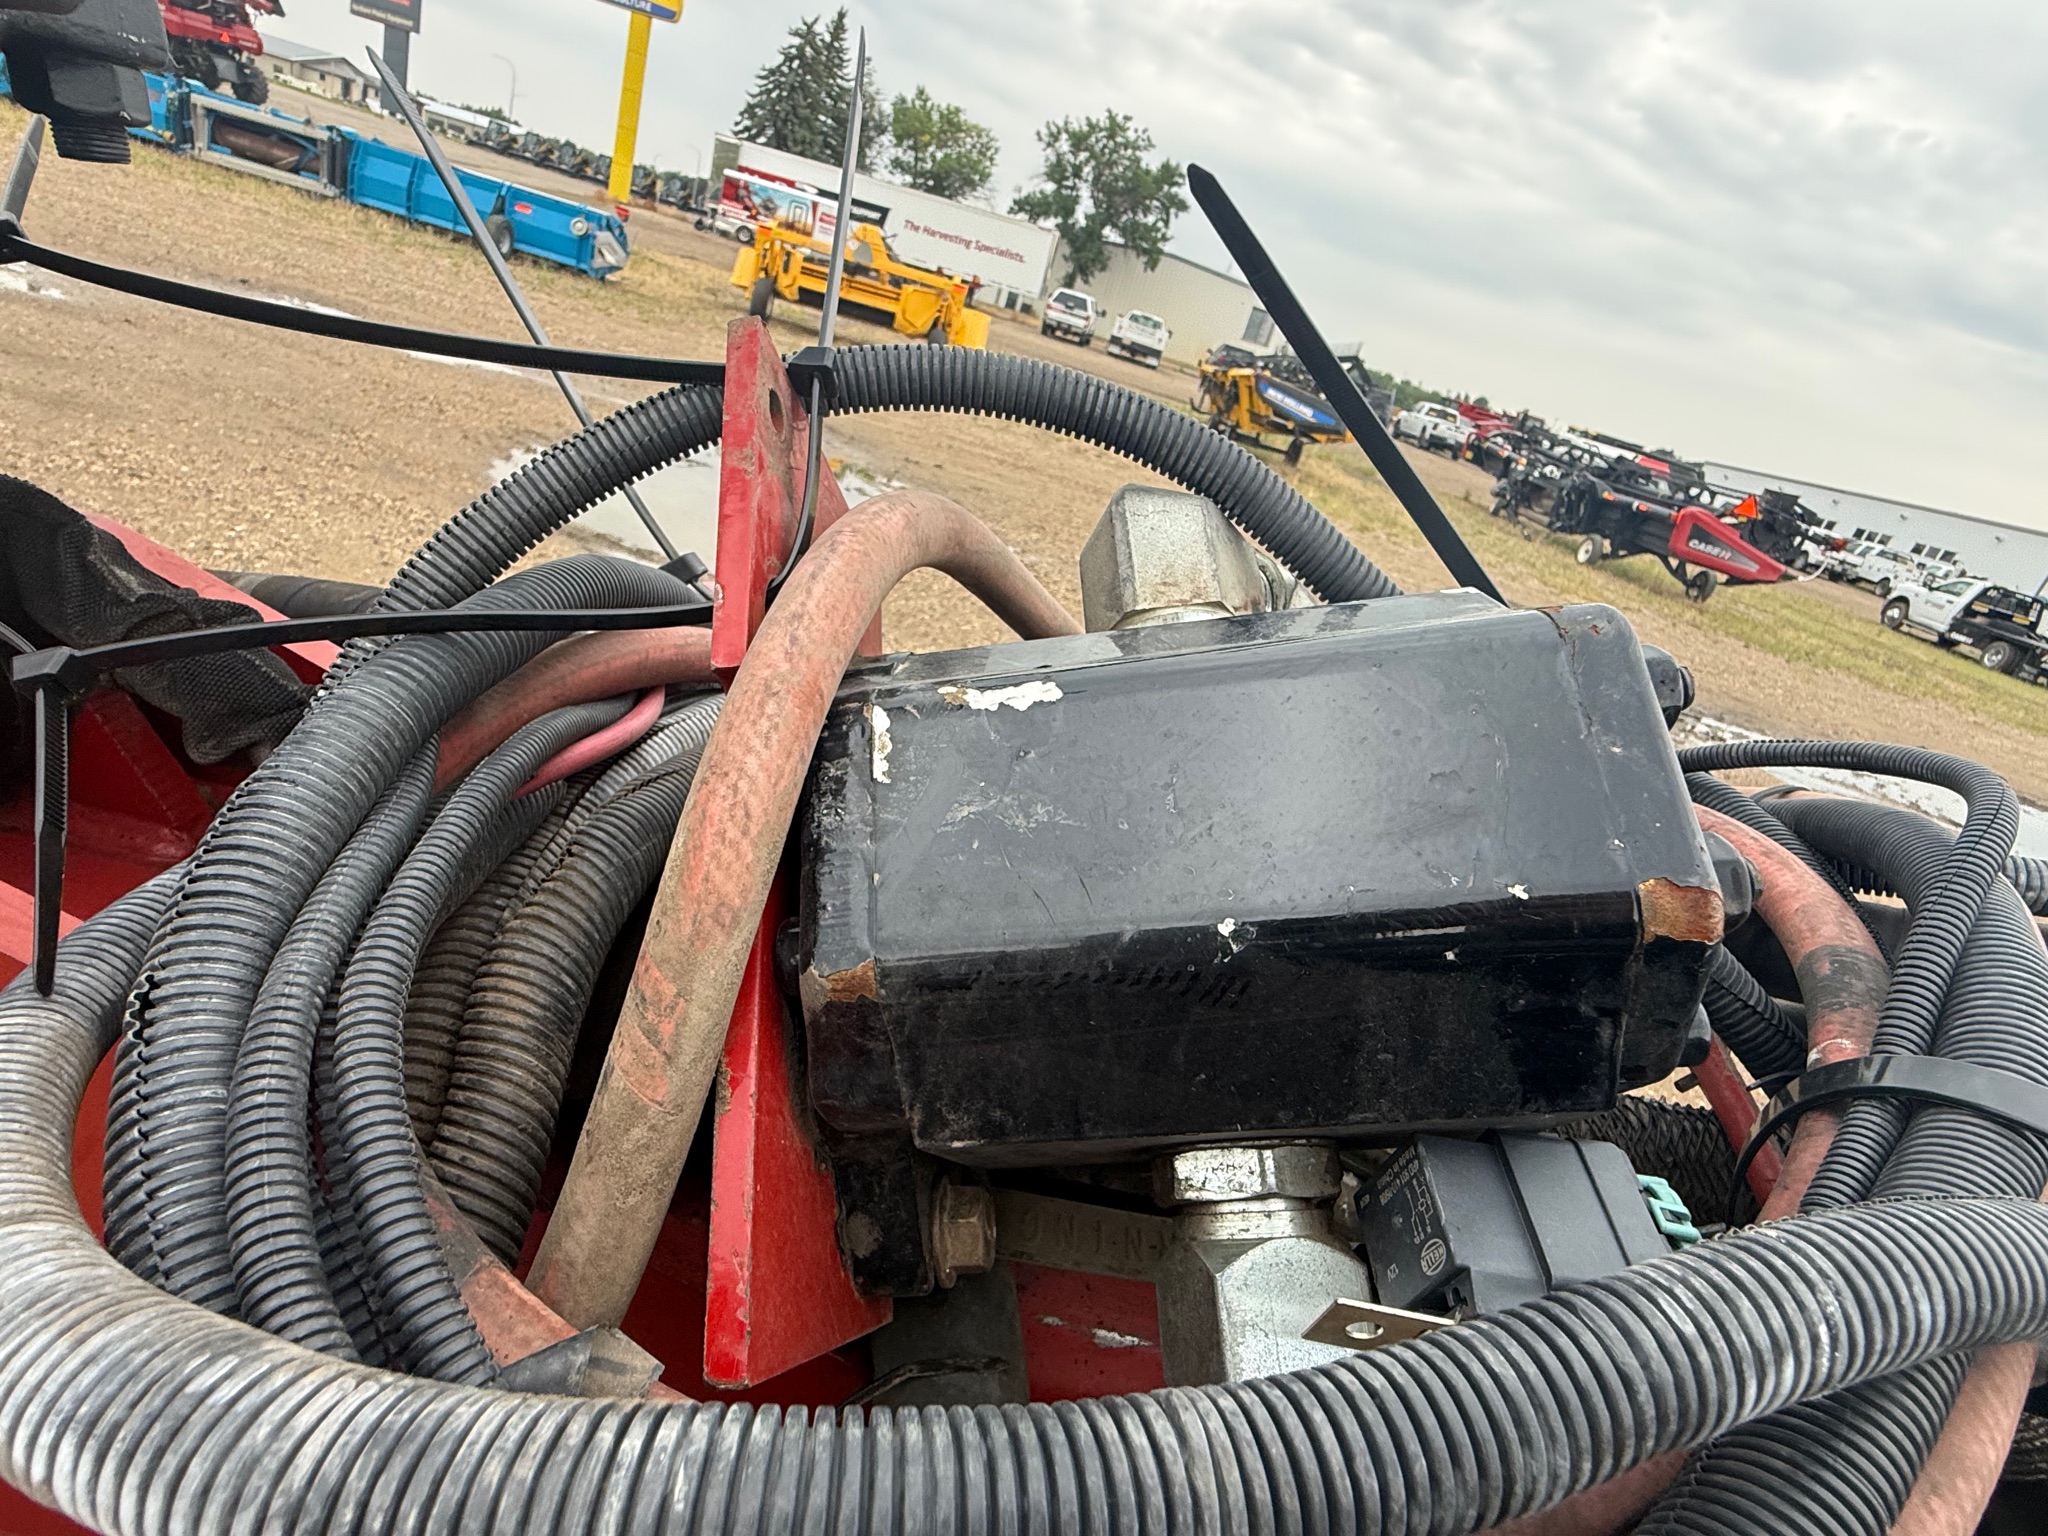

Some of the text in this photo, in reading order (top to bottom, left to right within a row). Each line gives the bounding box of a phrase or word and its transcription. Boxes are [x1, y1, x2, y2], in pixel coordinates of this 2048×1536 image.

[904, 218, 921, 234] The
[922, 225, 973, 250] Harvesting
[1387, 1262, 1399, 1283] 12V
[1420, 1242, 1445, 1275] HELLA
